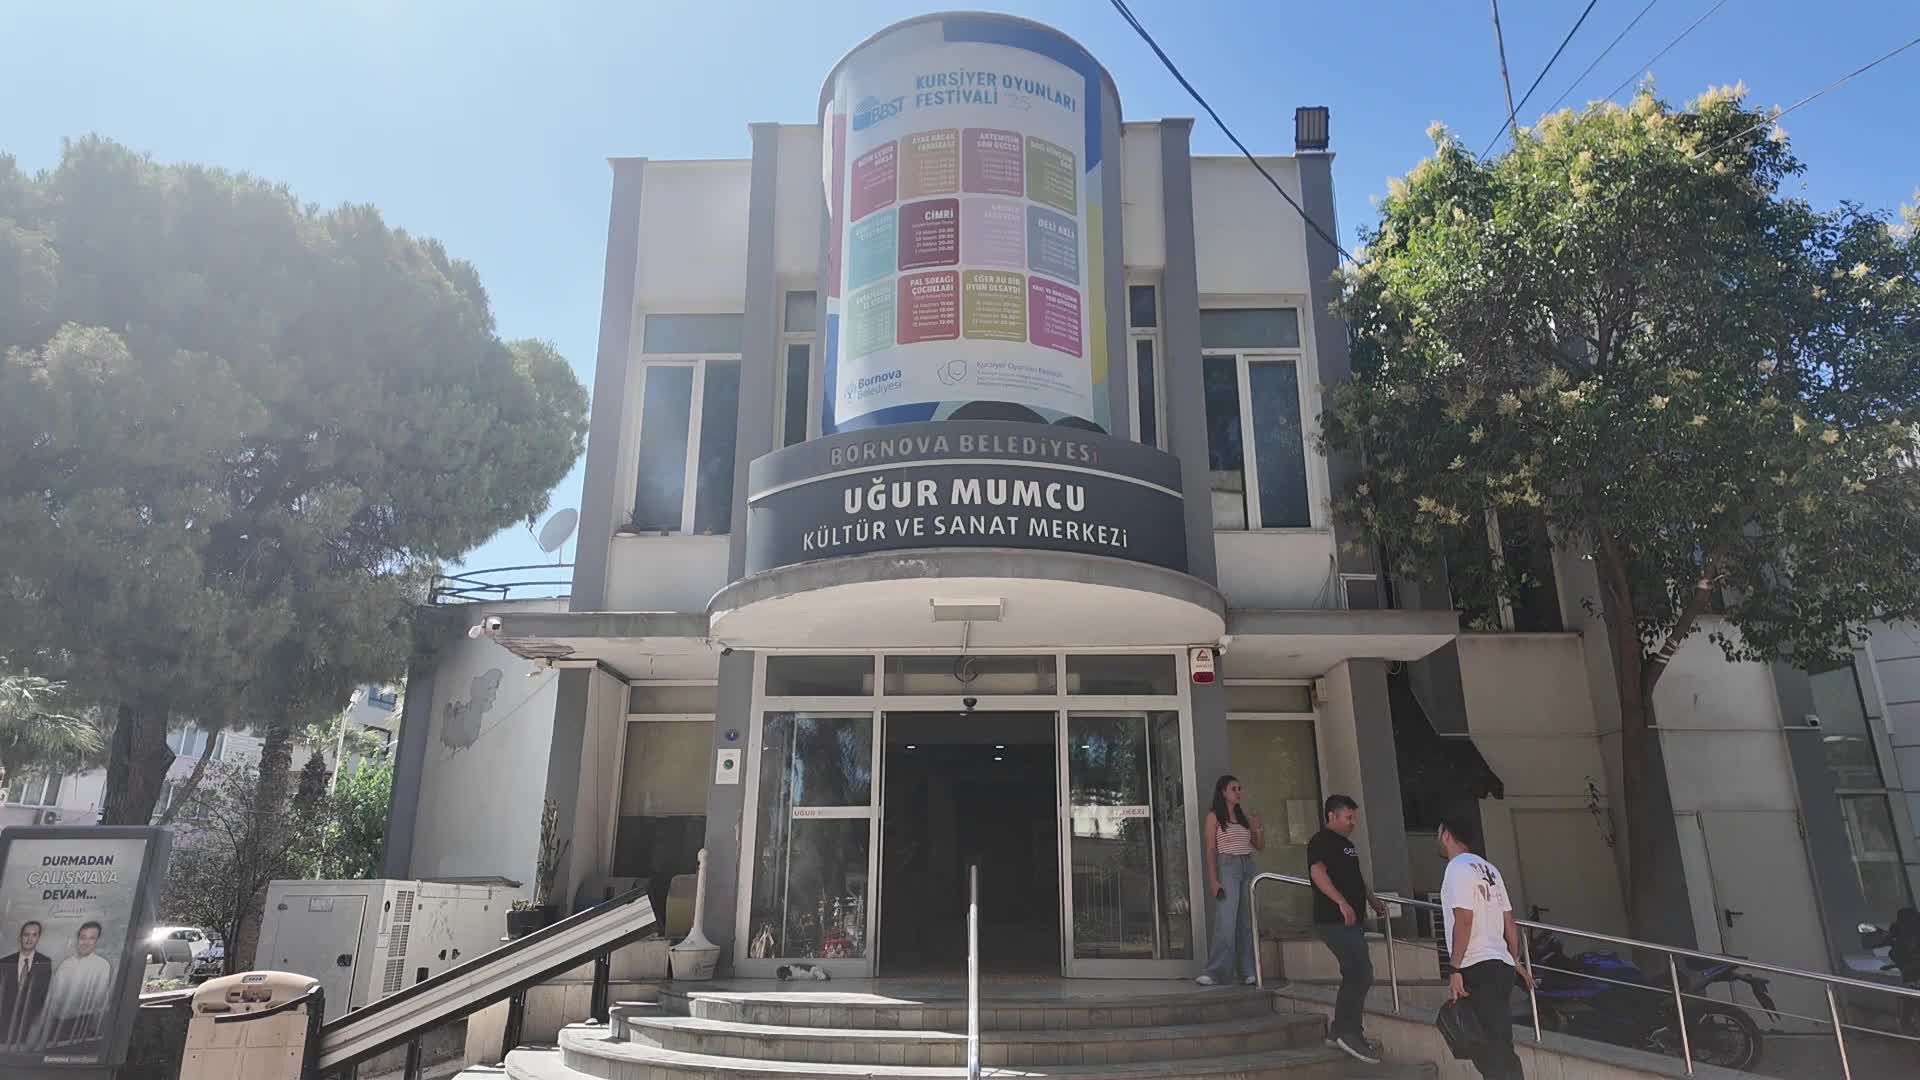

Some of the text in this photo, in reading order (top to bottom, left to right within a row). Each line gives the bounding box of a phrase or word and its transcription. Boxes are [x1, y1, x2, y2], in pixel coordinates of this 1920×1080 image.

[915, 68, 1076, 112] KURSİYER OYUNLARI
[915, 87, 998, 109] FESTİVALİ
[924, 208, 954, 221] CİMRİ
[912, 284, 954, 296] ÇOCUKLARI
[857, 368, 902, 389] Bornova
[857, 381, 902, 400] Belediyesi
[831, 434, 951, 467] BORNOVA
[844, 477, 1086, 515] UĞUR MUMCU
[802, 517, 886, 552] KÜLTÜR
[895, 517, 924, 538] VE
[934, 515, 1019, 537] SANAT
[42, 855, 114, 867] DURMADAN
[27, 869, 119, 888] ÇALIŞMAYA
[42, 889, 97, 901] DEVAM...
